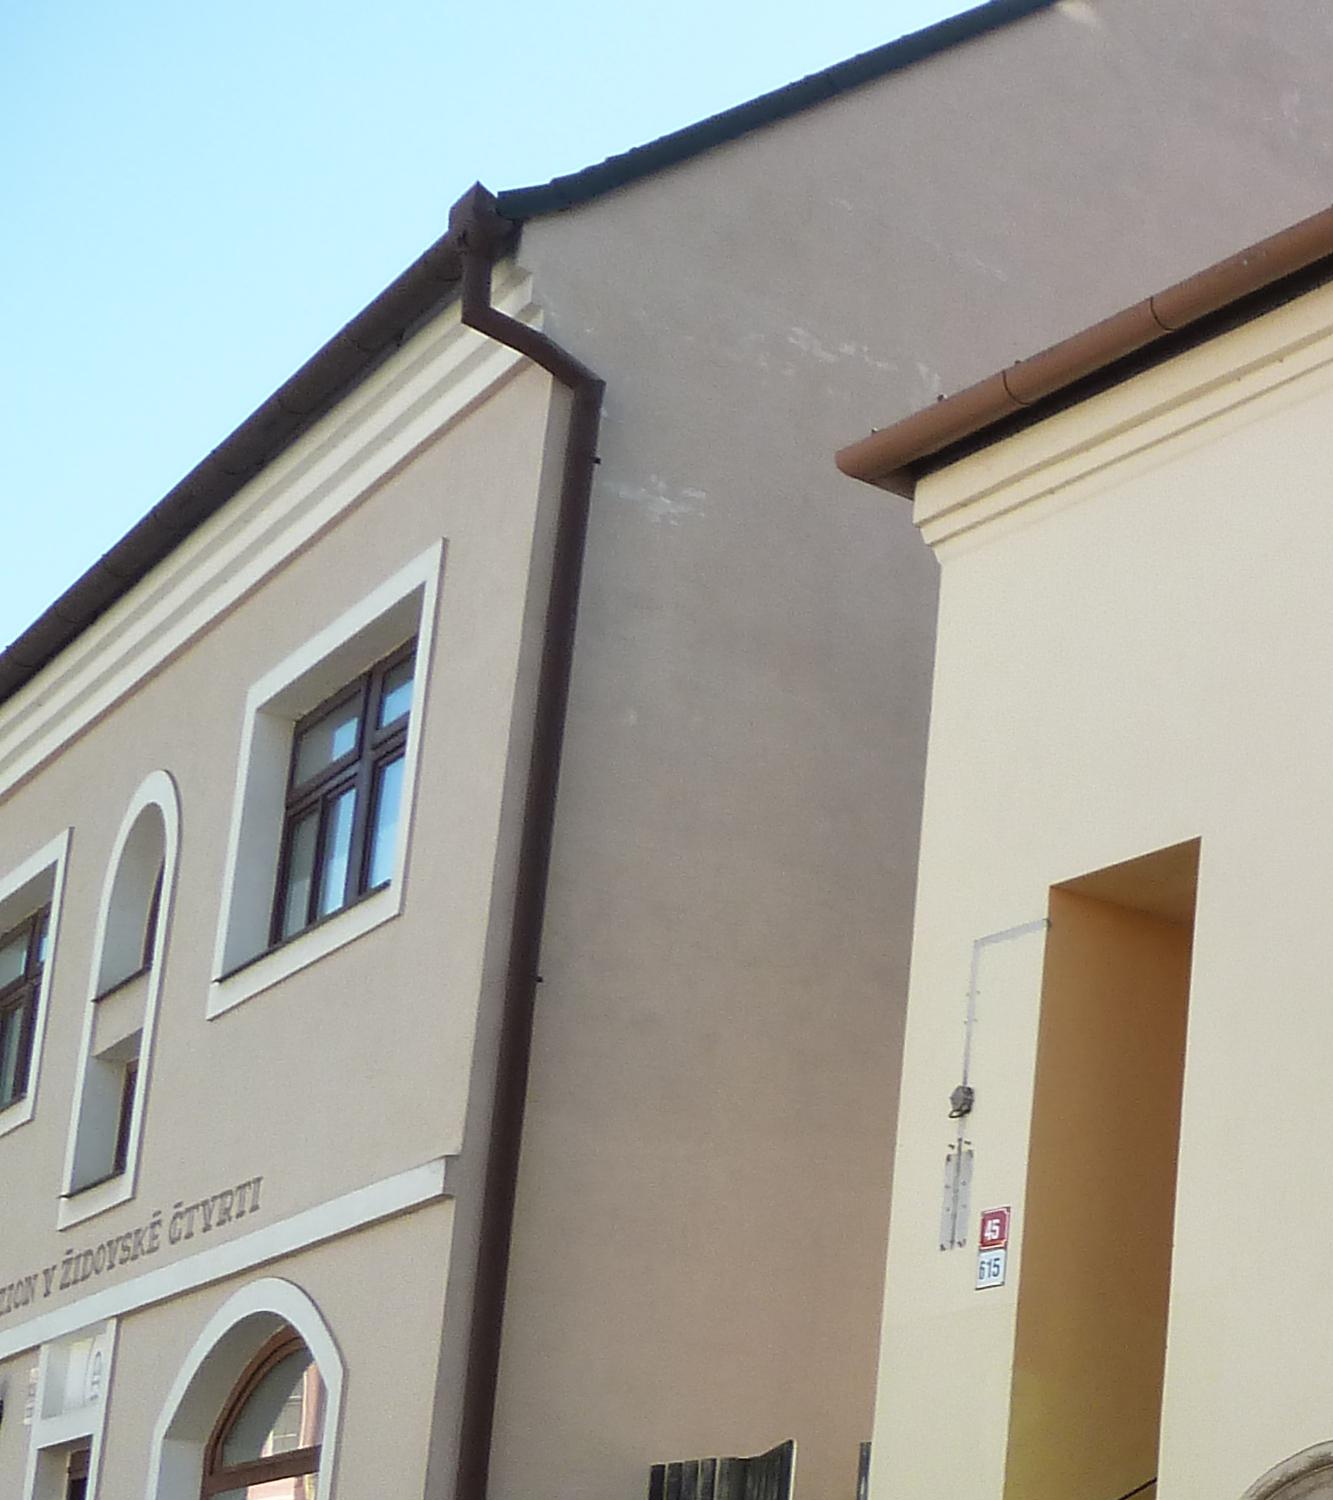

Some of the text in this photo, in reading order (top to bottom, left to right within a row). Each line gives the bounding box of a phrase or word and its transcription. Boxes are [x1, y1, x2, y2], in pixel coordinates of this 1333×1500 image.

[984, 1219, 1001, 1241] 45
[59, 1210, 163, 1291] ŽIDOVSKÉ
[979, 1257, 1001, 1280] 615
